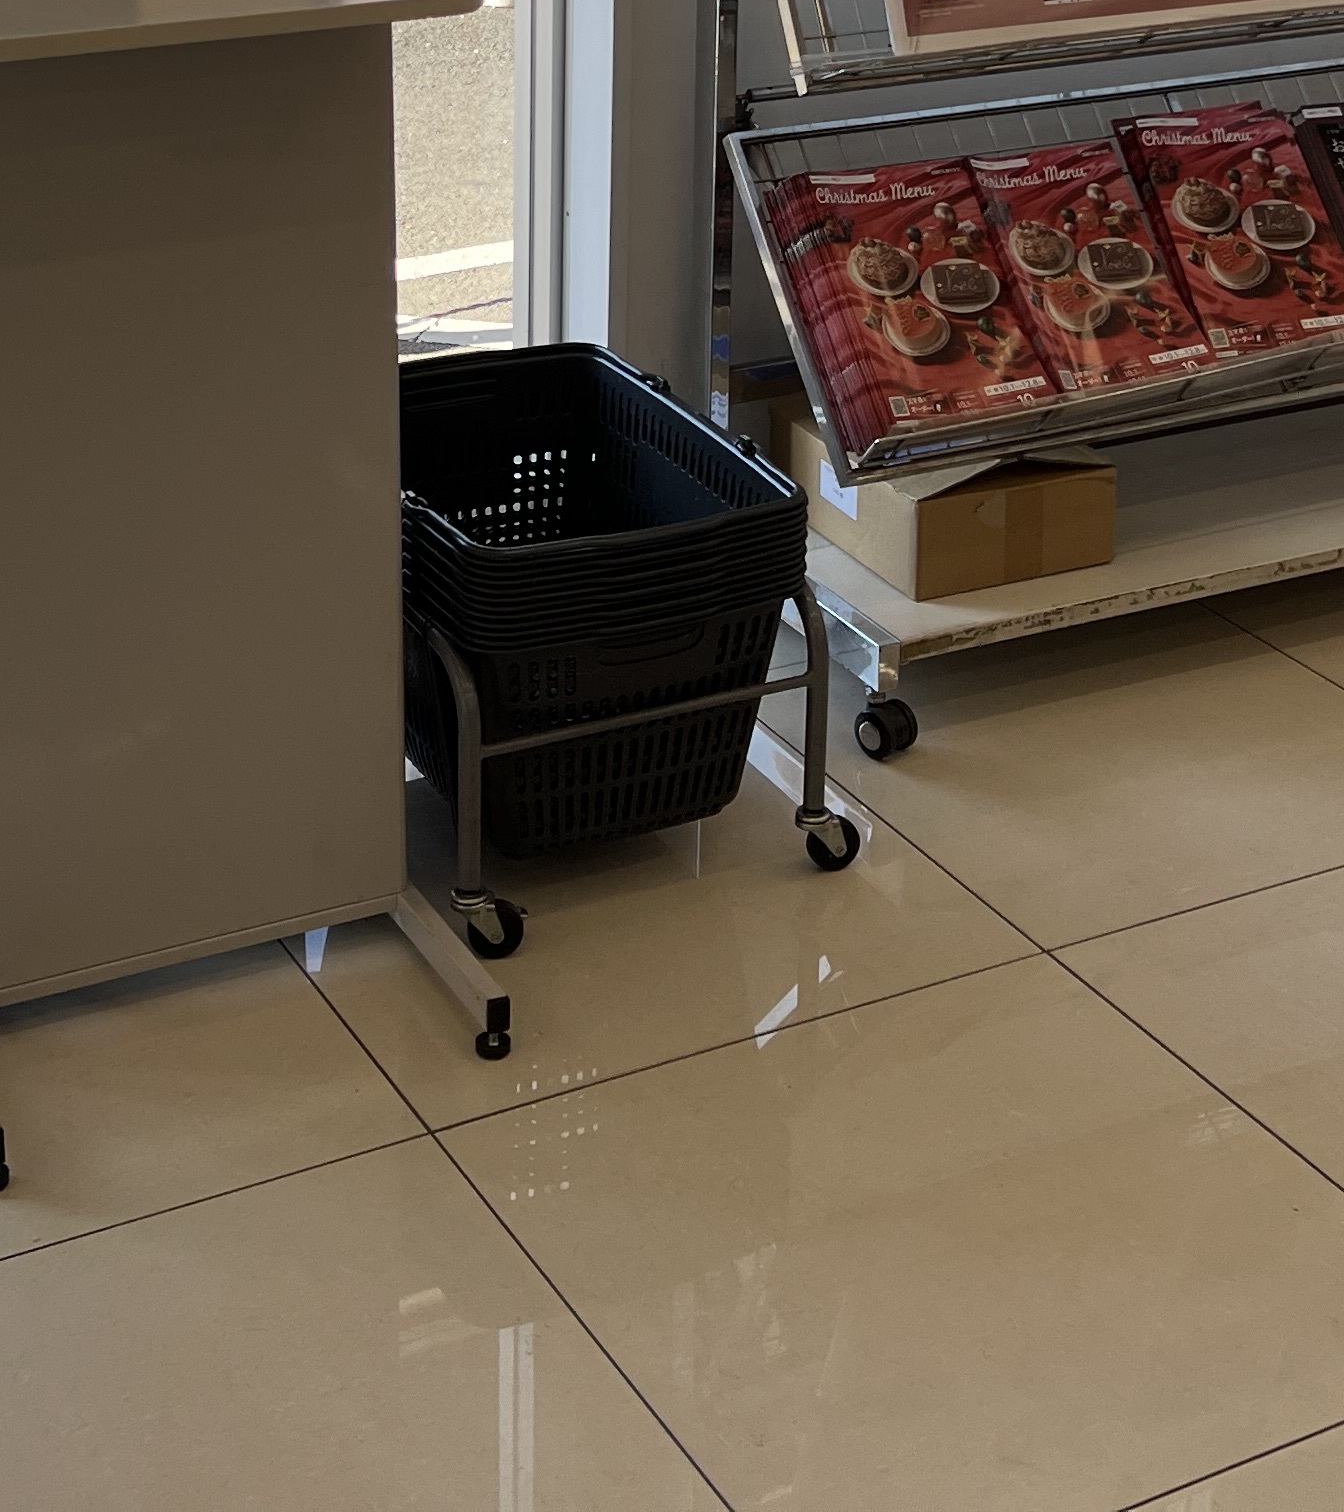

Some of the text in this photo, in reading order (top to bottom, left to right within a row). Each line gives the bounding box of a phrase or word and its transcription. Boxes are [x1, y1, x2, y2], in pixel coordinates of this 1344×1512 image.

[1141, 127, 1253, 147] Christmas Menu
[975, 164, 1087, 189] Christmas Menu
[815, 182, 936, 204] Christmas Menu
